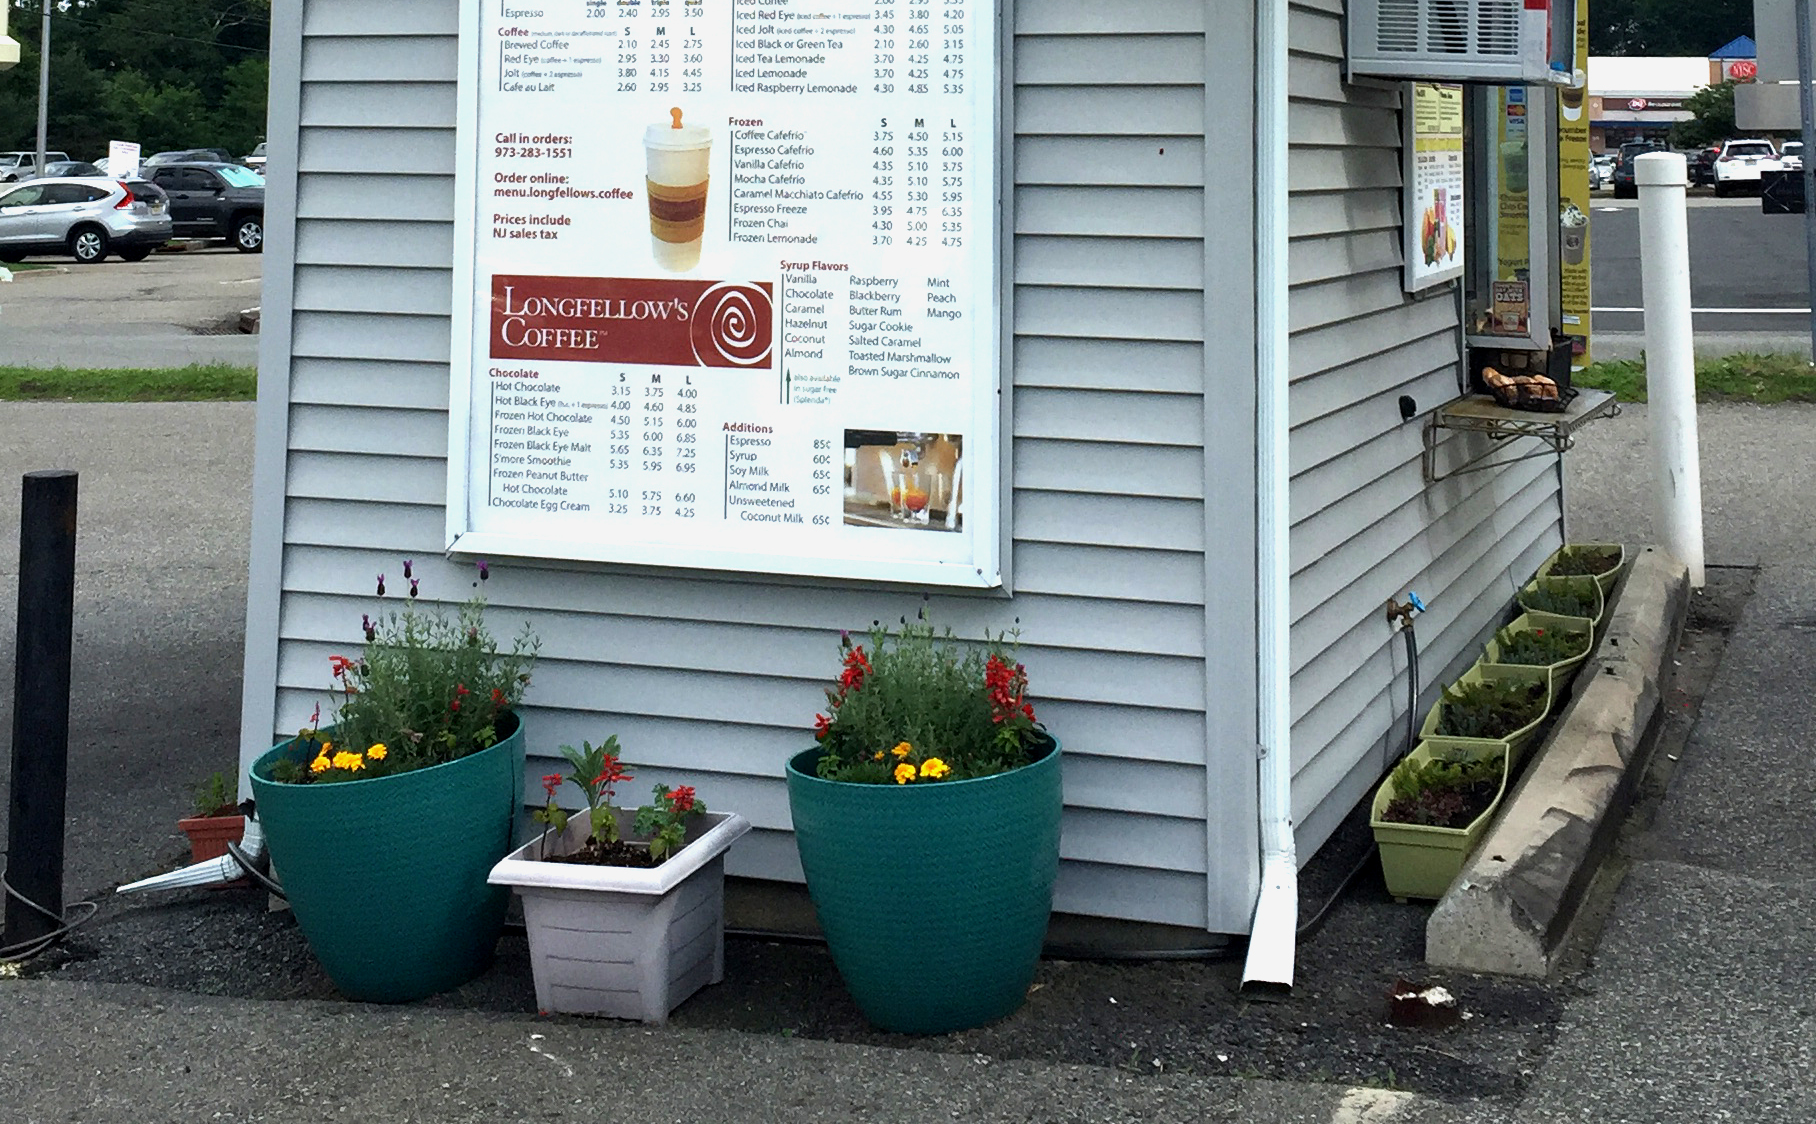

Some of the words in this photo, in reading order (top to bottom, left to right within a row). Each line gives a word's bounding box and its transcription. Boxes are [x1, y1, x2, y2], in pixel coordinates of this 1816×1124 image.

[505, 8, 544, 19] Espresso
[498, 27, 529, 37] Coffee
[624, 26, 631, 36] S
[656, 27, 665, 35] M
[690, 27, 695, 36] L
[504, 40, 538, 50] Brewed
[540, 39, 569, 50] Coffee
[618, 39, 637, 49] 2.10
[650, 39, 670, 49] 2.45
[683, 39, 703, 49] 2.75
[736, 39, 755, 49] Iced
[757, 39, 782, 49] Black
[784, 41, 794, 49] or
[796, 39, 825, 49] Green
[827, 39, 843, 49] Tea
[504, 54, 522, 64] Red
[523, 54, 539, 65] Eye
[504, 69, 520, 78] Jolt
[503, 82, 523, 92] Cafe
[538, 82, 555, 92] Lait
[735, 83, 755, 93] Iced
[757, 82, 805, 95] Raspberry
[807, 83, 858, 93] Lemonade
[729, 117, 763, 127] Frozen
[495, 132, 516, 144] Call
[519, 133, 530, 144] in
[532, 133, 572, 144] orders:
[734, 130, 765, 140] Coffee
[495, 147, 572, 158] 973-283-1551
[734, 144, 776, 156] Espresso
[494, 172, 527, 183] Order
[529, 172, 569, 184] online:
[494, 186, 633, 201] menu.longfellows.coffee
[733, 203, 775, 215] Espresso
[776, 204, 808, 214] Freeze
[493, 213, 527, 225] Prices
[529, 214, 571, 226] include
[493, 227, 507, 238] NJ
[509, 228, 537, 239] sales
[540, 229, 558, 239] tax
[733, 232, 765, 243] Frozen
[767, 233, 818, 244] Lemonade
[780, 260, 810, 272] Syrup
[812, 261, 849, 271] Flavors
[785, 273, 817, 284] Vanilla
[849, 275, 898, 289] Raspberry
[927, 277, 950, 288] Mint
[785, 288, 834, 299] Chocolate
[849, 290, 901, 304] Blackberry
[927, 292, 956, 303] Peach
[1495, 292, 1524, 303] OATS
[502, 285, 689, 322] LONGFELLOW'S
[785, 303, 825, 314] Caramel
[849, 305, 878, 316] Butter
[880, 306, 902, 316] Rum
[927, 308, 962, 321] Mango
[785, 318, 828, 329] Hazelnut
[849, 320, 877, 333] Sugar
[879, 321, 913, 332] Cookie
[501, 316, 600, 349] COFFEE
[784, 332, 825, 344] Coconut
[849, 335, 879, 346] Salted
[881, 336, 921, 348] Caramel
[784, 348, 823, 359] Almond
[849, 350, 885, 361] Toasted
[887, 352, 951, 364] Marshmallow
[488, 368, 539, 379] Chocolate
[848, 365, 879, 376] Brown
[881, 366, 908, 380] Sugar
[910, 367, 960, 380] Cinnamon
[495, 381, 512, 391] Hot
[514, 381, 561, 393] Chocolate
[611, 385, 631, 396] 3.15
[645, 387, 664, 398] 3.75
[677, 388, 697, 399] 4.00
[495, 409, 526, 420] Frozen
[527, 411, 544, 421] Hot
[546, 411, 593, 423] Chocolate
[722, 422, 773, 435] Additions
[730, 435, 771, 447] Espresso
[527, 453, 571, 466] Smoothie
[729, 450, 757, 462] Syrup
[729, 464, 747, 478] Soy
[749, 466, 769, 476] Milk
[492, 497, 539, 509] Chocolate
[540, 499, 558, 512] Egg
[560, 500, 590, 511] Cream
